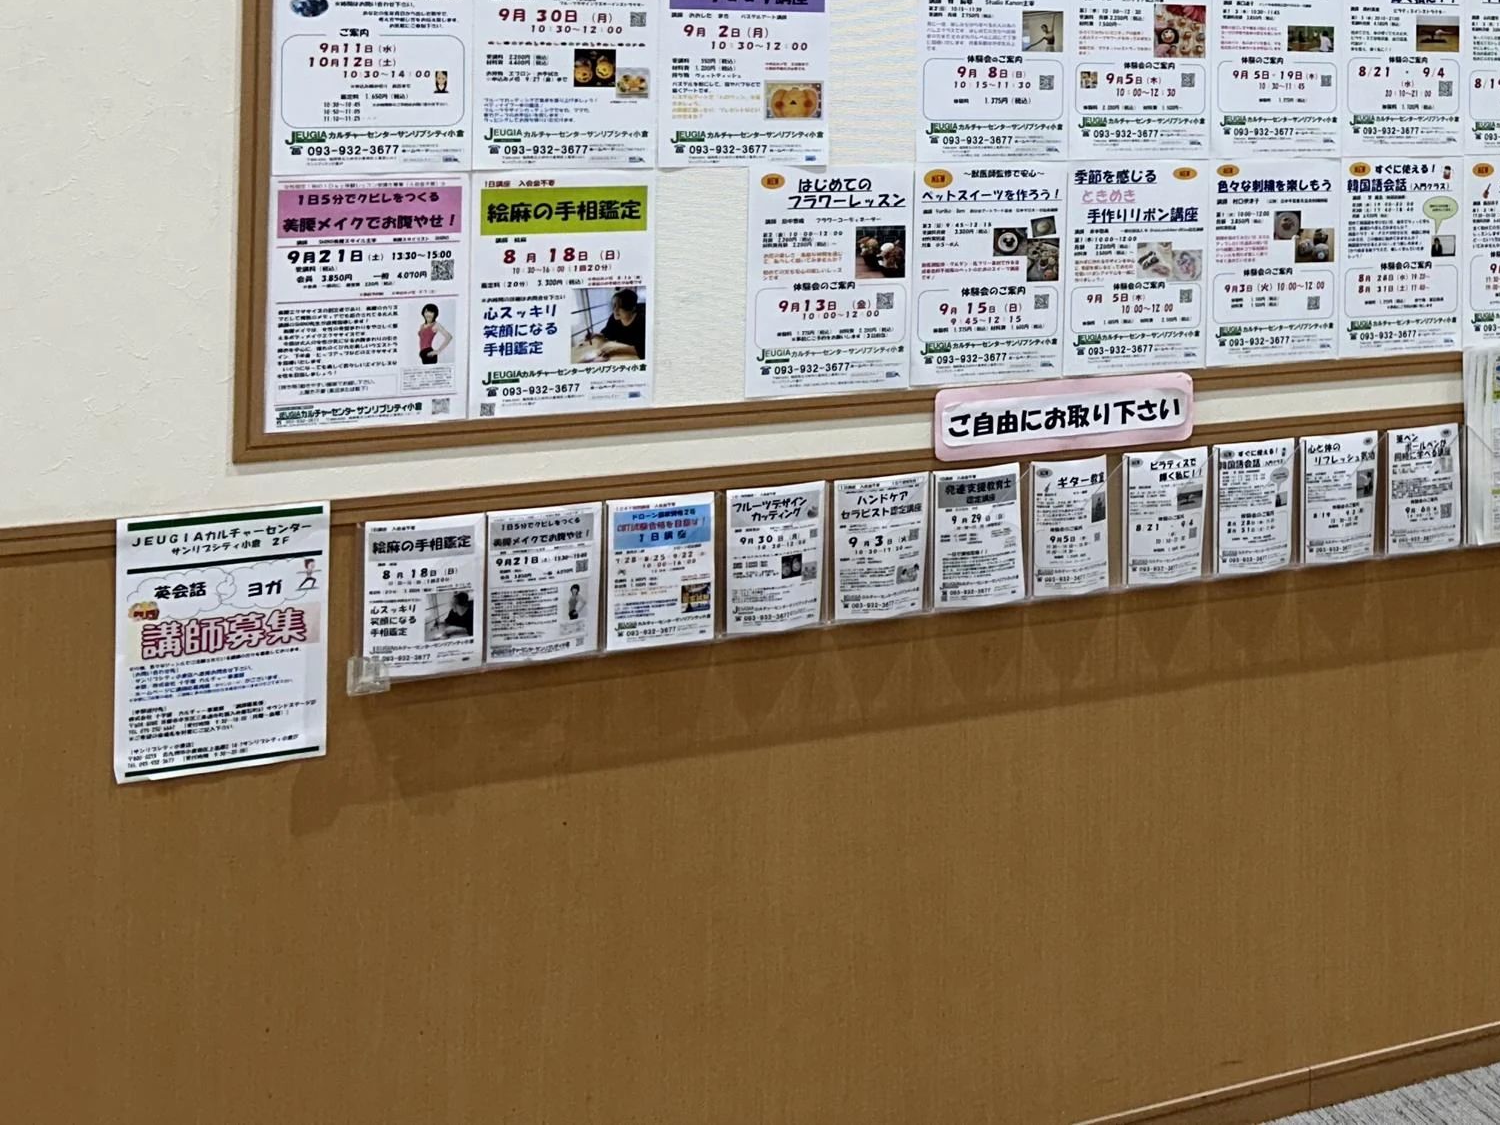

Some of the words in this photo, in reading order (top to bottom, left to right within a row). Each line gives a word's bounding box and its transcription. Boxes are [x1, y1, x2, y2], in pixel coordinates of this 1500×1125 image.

[339, 29, 370, 38] ご案内
[942, 135, 1013, 145] 093-932-3677
[307, 145, 399, 156] 093-932-3677
[504, 144, 588, 155] 093-932-3677
[689, 144, 767, 155] 093-932-3677
[1074, 170, 1157, 184] 季節を感じる
[1375, 164, 1436, 175] すぐに使える！
[798, 178, 872, 193] はじめての
[1347, 178, 1407, 192] 韓国語会話
[298, 192, 440, 206] 1日5分でクビレをつくる
[788, 194, 906, 209] フラワーレッスン
[922, 189, 1059, 201] ペットスイーツを作ろう！
[1082, 189, 1136, 203] ときめき
[487, 200, 641, 224] 絵麻の手相鑑定
[1087, 207, 1198, 223] 手作りリボン講座
[483, 304, 557, 320] 心スッキリ
[483, 322, 558, 338] 笑顔になる
[483, 341, 543, 356] 手相鑑定
[503, 383, 580, 397] 093-932-3677
[948, 398, 1181, 438] ご自由にお取り下さい
[732, 496, 808, 513] フルーツデザイン
[857, 491, 908, 506] ハンドケア
[751, 507, 802, 522] カッティング
[131, 522, 312, 547] JEUGIAカルチャーセンター
[171, 538, 261, 556] サンリブシティ小倉
[272, 536, 290, 547] 2F
[154, 582, 207, 600] 英会話
[247, 579, 282, 597] ヨガ
[141, 607, 307, 661] 講師募集
